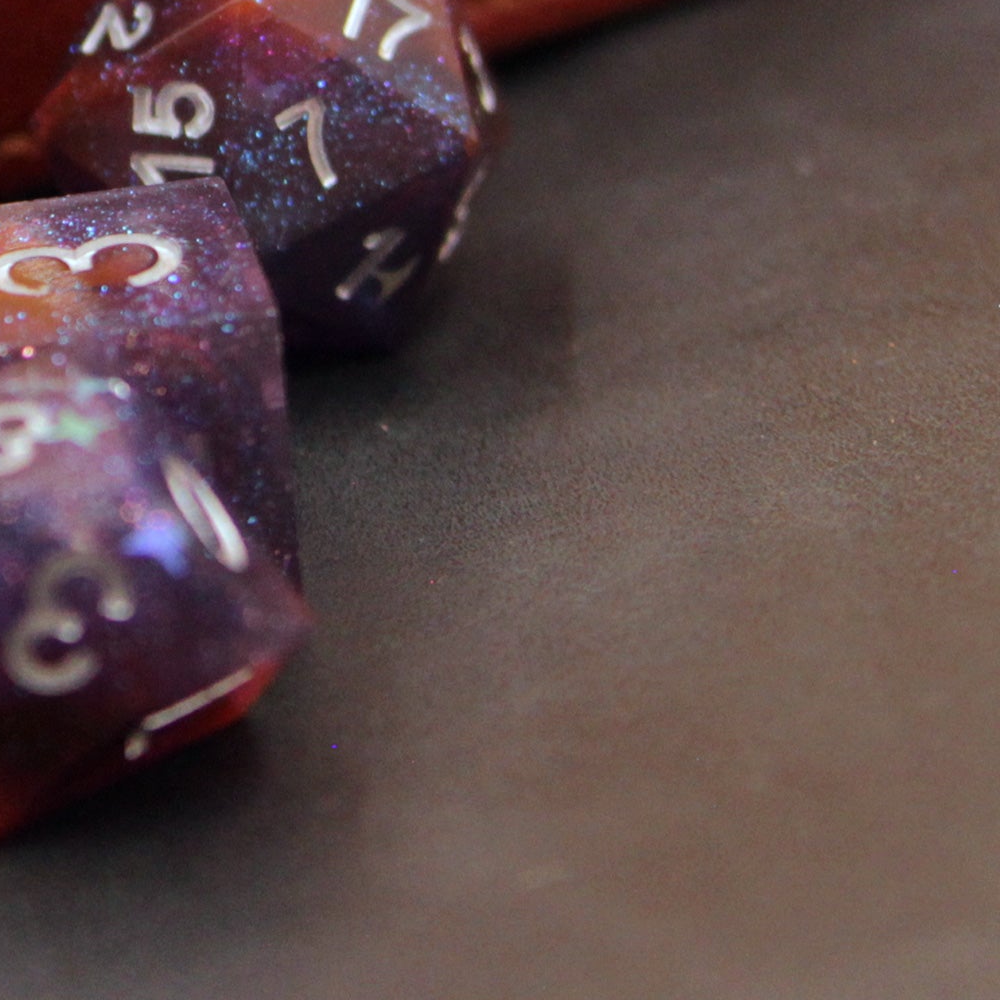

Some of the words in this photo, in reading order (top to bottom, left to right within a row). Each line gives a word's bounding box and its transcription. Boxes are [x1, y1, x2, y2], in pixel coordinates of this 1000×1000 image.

[131, 81, 215, 186] 15
[275, 98, 337, 188] 7
[160, 456, 250, 572] 0
[3, 553, 136, 696] 3
